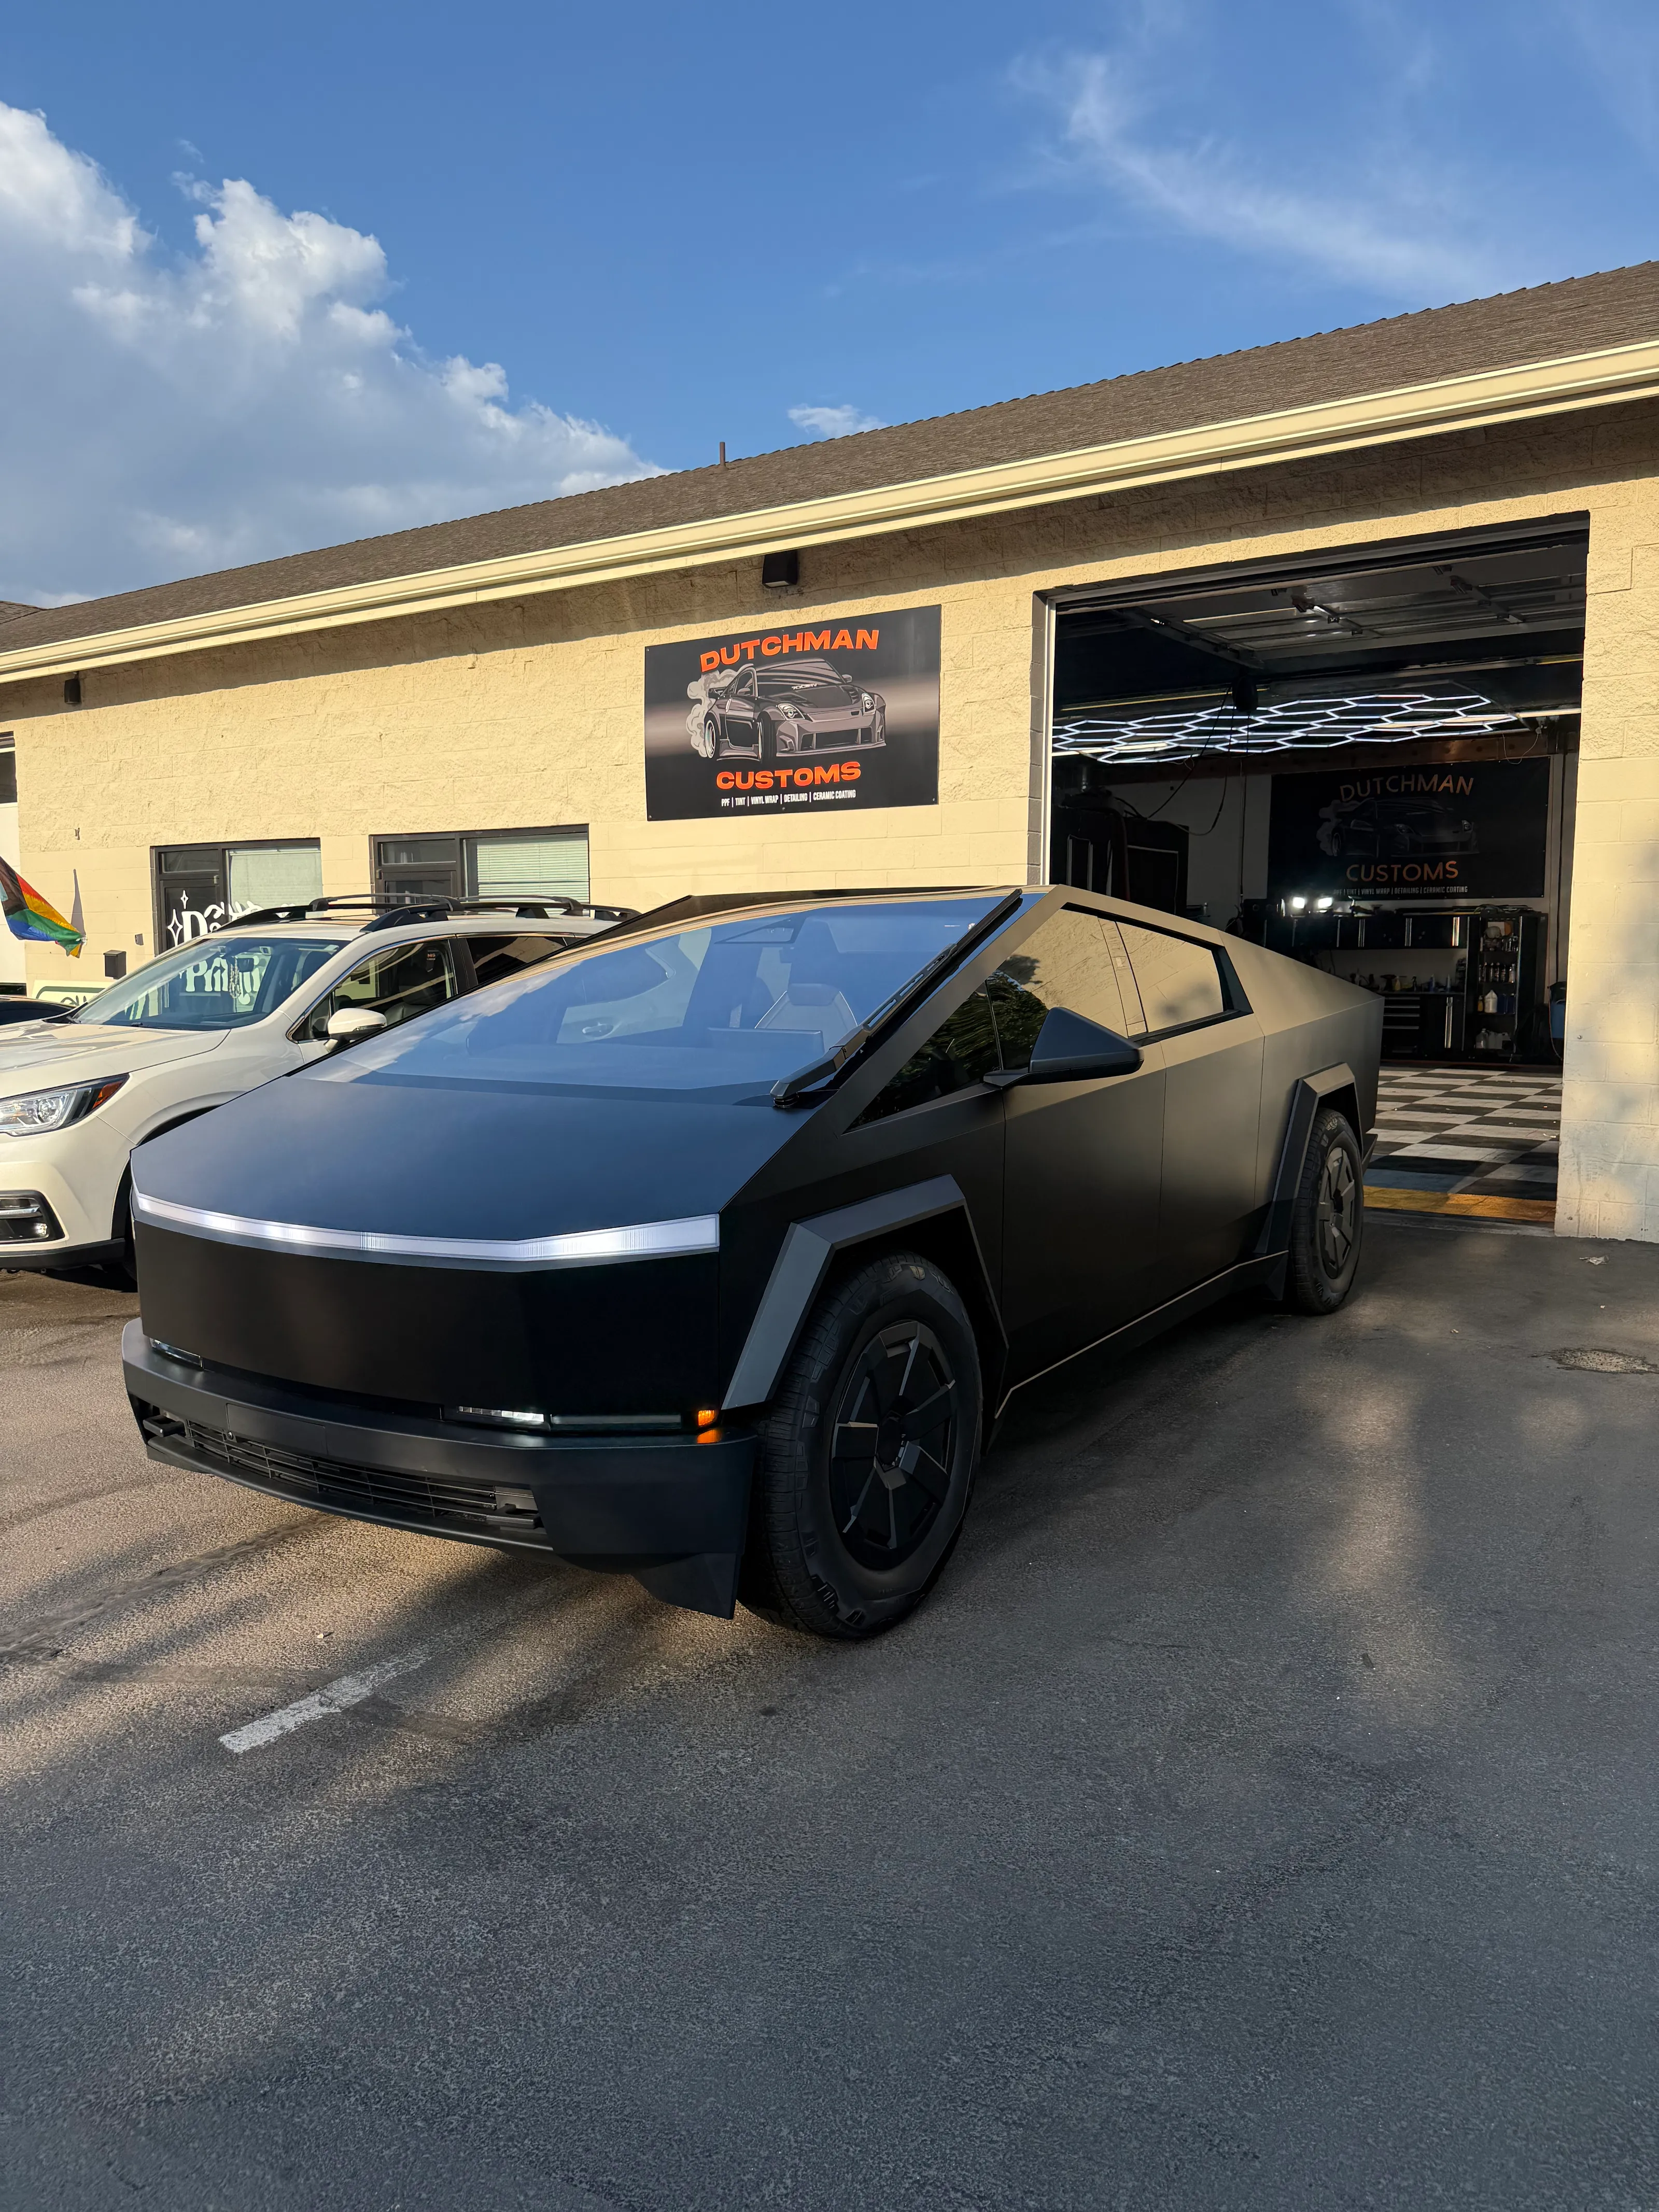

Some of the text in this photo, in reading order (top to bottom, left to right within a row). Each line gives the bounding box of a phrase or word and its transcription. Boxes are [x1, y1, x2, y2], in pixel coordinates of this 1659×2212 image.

[700, 629, 879, 673] DUTCHMAN
[715, 761, 862, 790] CUSTOMS
[1340, 774, 1474, 802] DUTCHMAN
[721, 790, 856, 807] PPF TINT VINYL WRAP DETAILING CERAMIC COATING
[1346, 860, 1459, 882] CUSTOMS
